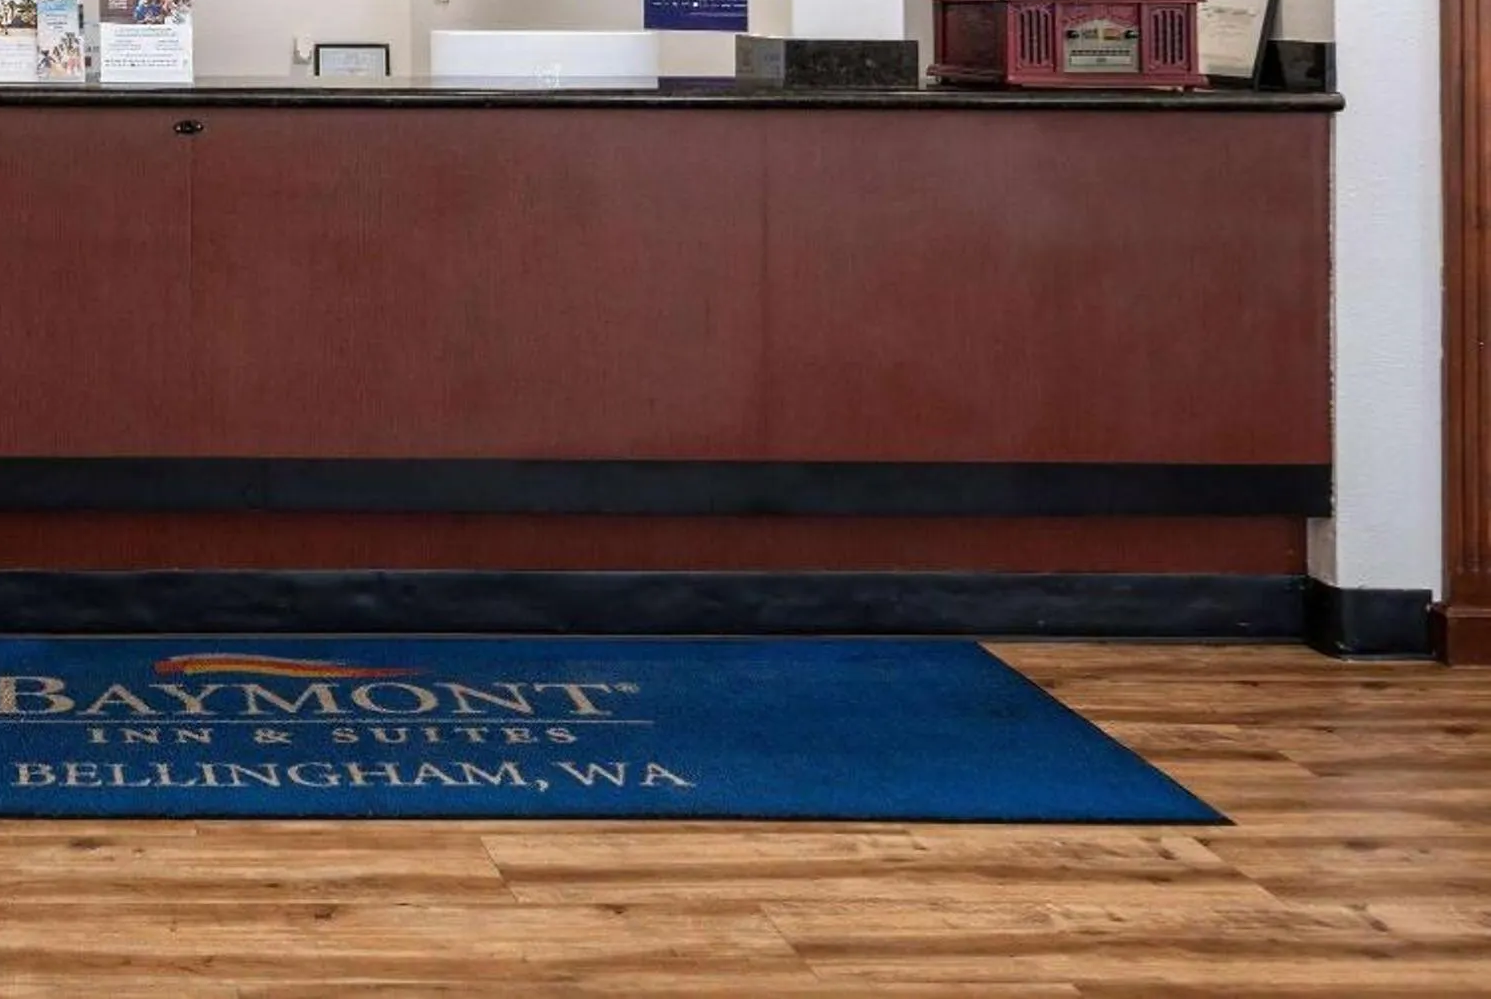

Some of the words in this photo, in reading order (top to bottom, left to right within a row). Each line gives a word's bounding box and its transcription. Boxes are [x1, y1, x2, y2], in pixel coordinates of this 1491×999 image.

[86, 727, 213, 744] INN
[253, 727, 294, 744] &
[331, 727, 578, 744] SUITES
[551, 761, 697, 788] WA
